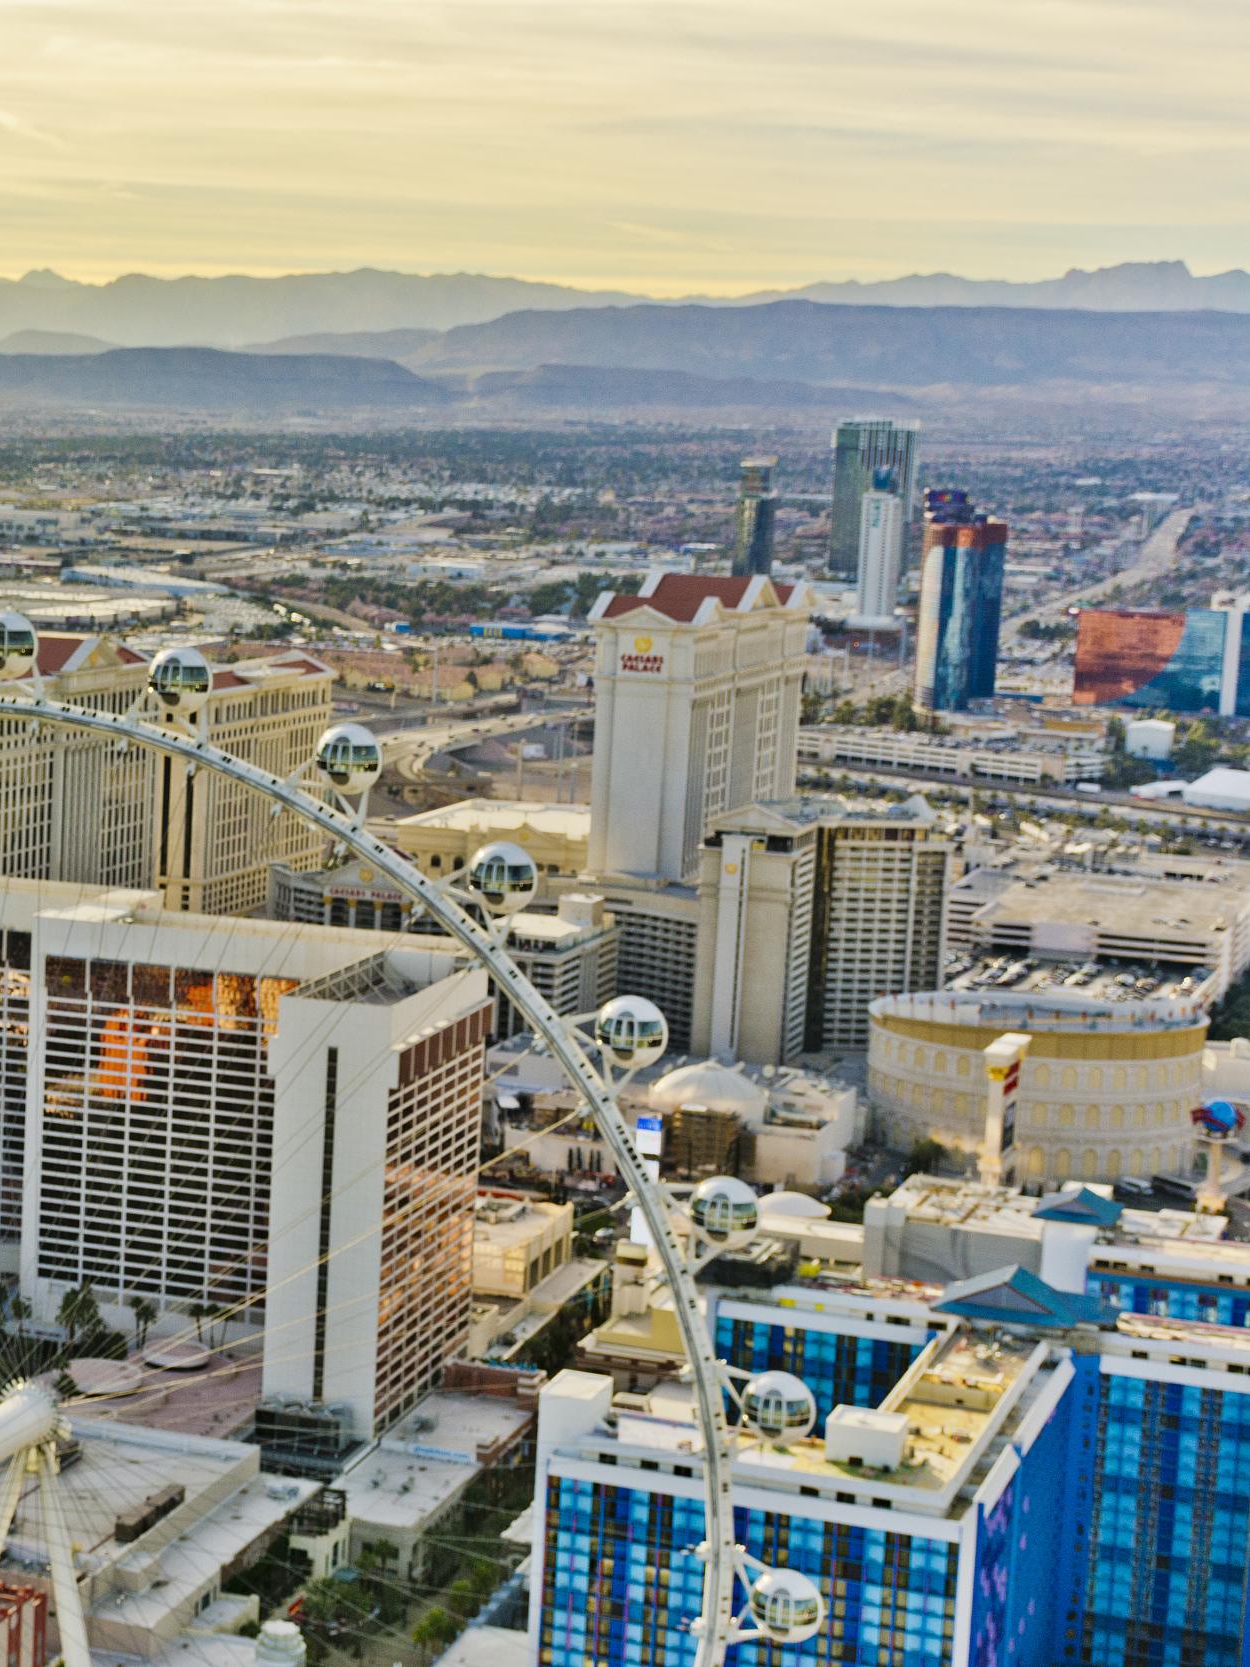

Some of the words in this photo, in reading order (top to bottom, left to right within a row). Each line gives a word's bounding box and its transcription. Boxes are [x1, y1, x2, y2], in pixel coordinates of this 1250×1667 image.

[621, 653, 664, 664] CAESARS
[622, 662, 662, 673] PALACE
[329, 886, 366, 897] CAESARS
[370, 889, 403, 901] PALACE
